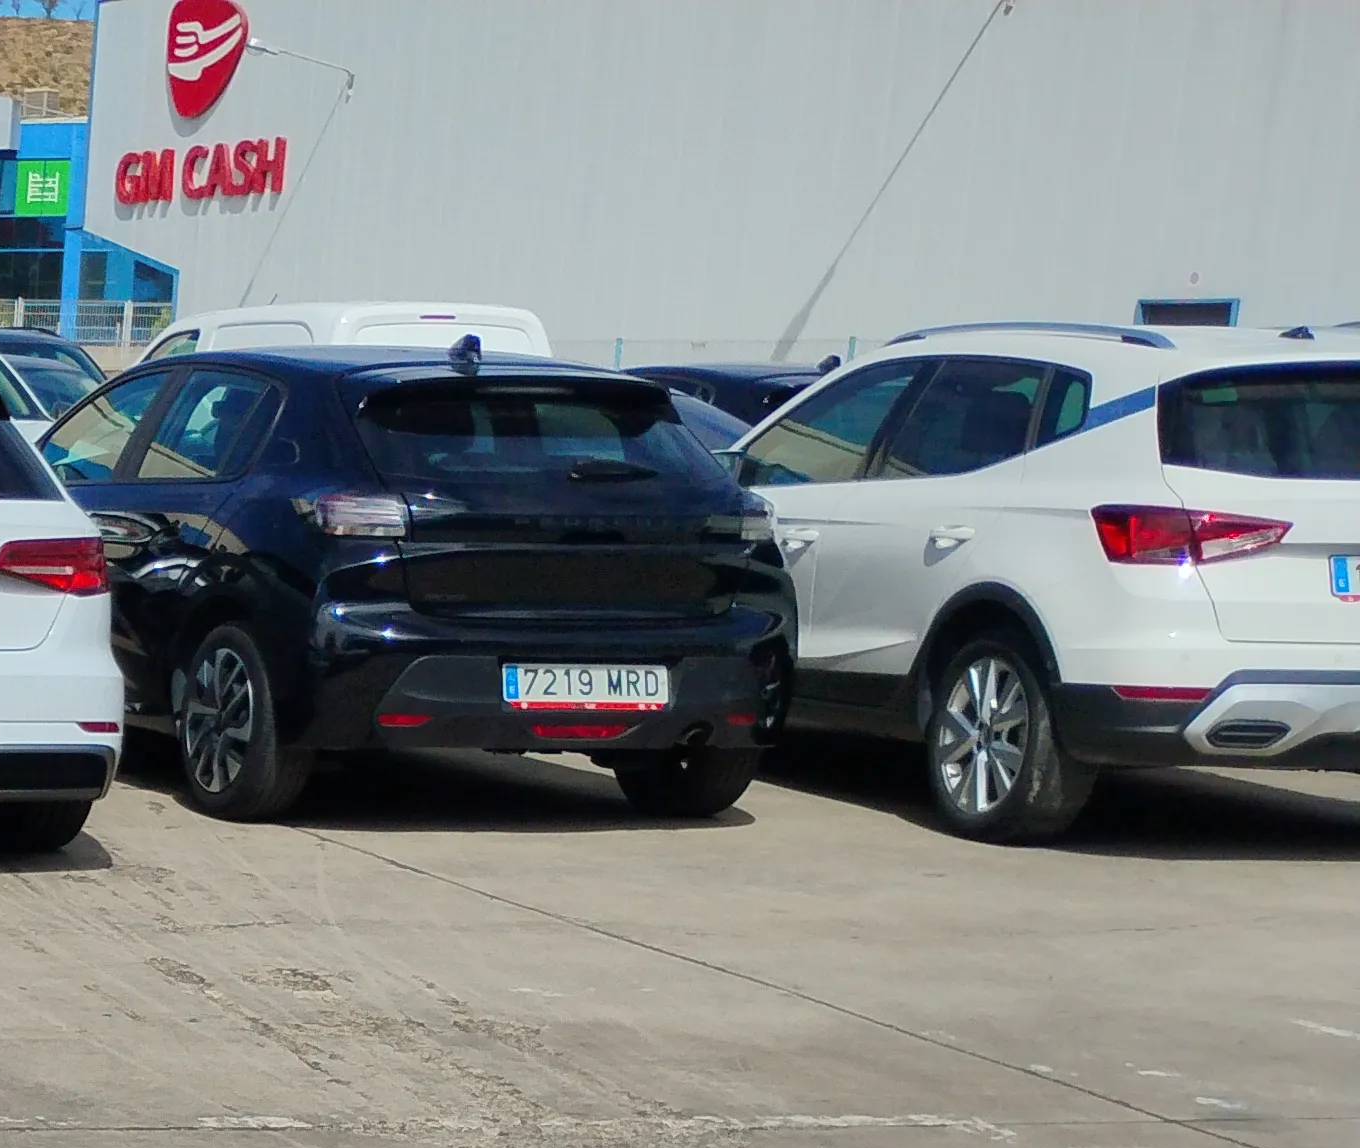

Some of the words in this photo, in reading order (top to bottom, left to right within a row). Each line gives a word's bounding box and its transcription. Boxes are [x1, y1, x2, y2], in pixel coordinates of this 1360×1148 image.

[115, 148, 175, 205] GM
[182, 136, 287, 200] CASH
[523, 669, 594, 696] 7219
[607, 669, 659, 697] MRD
